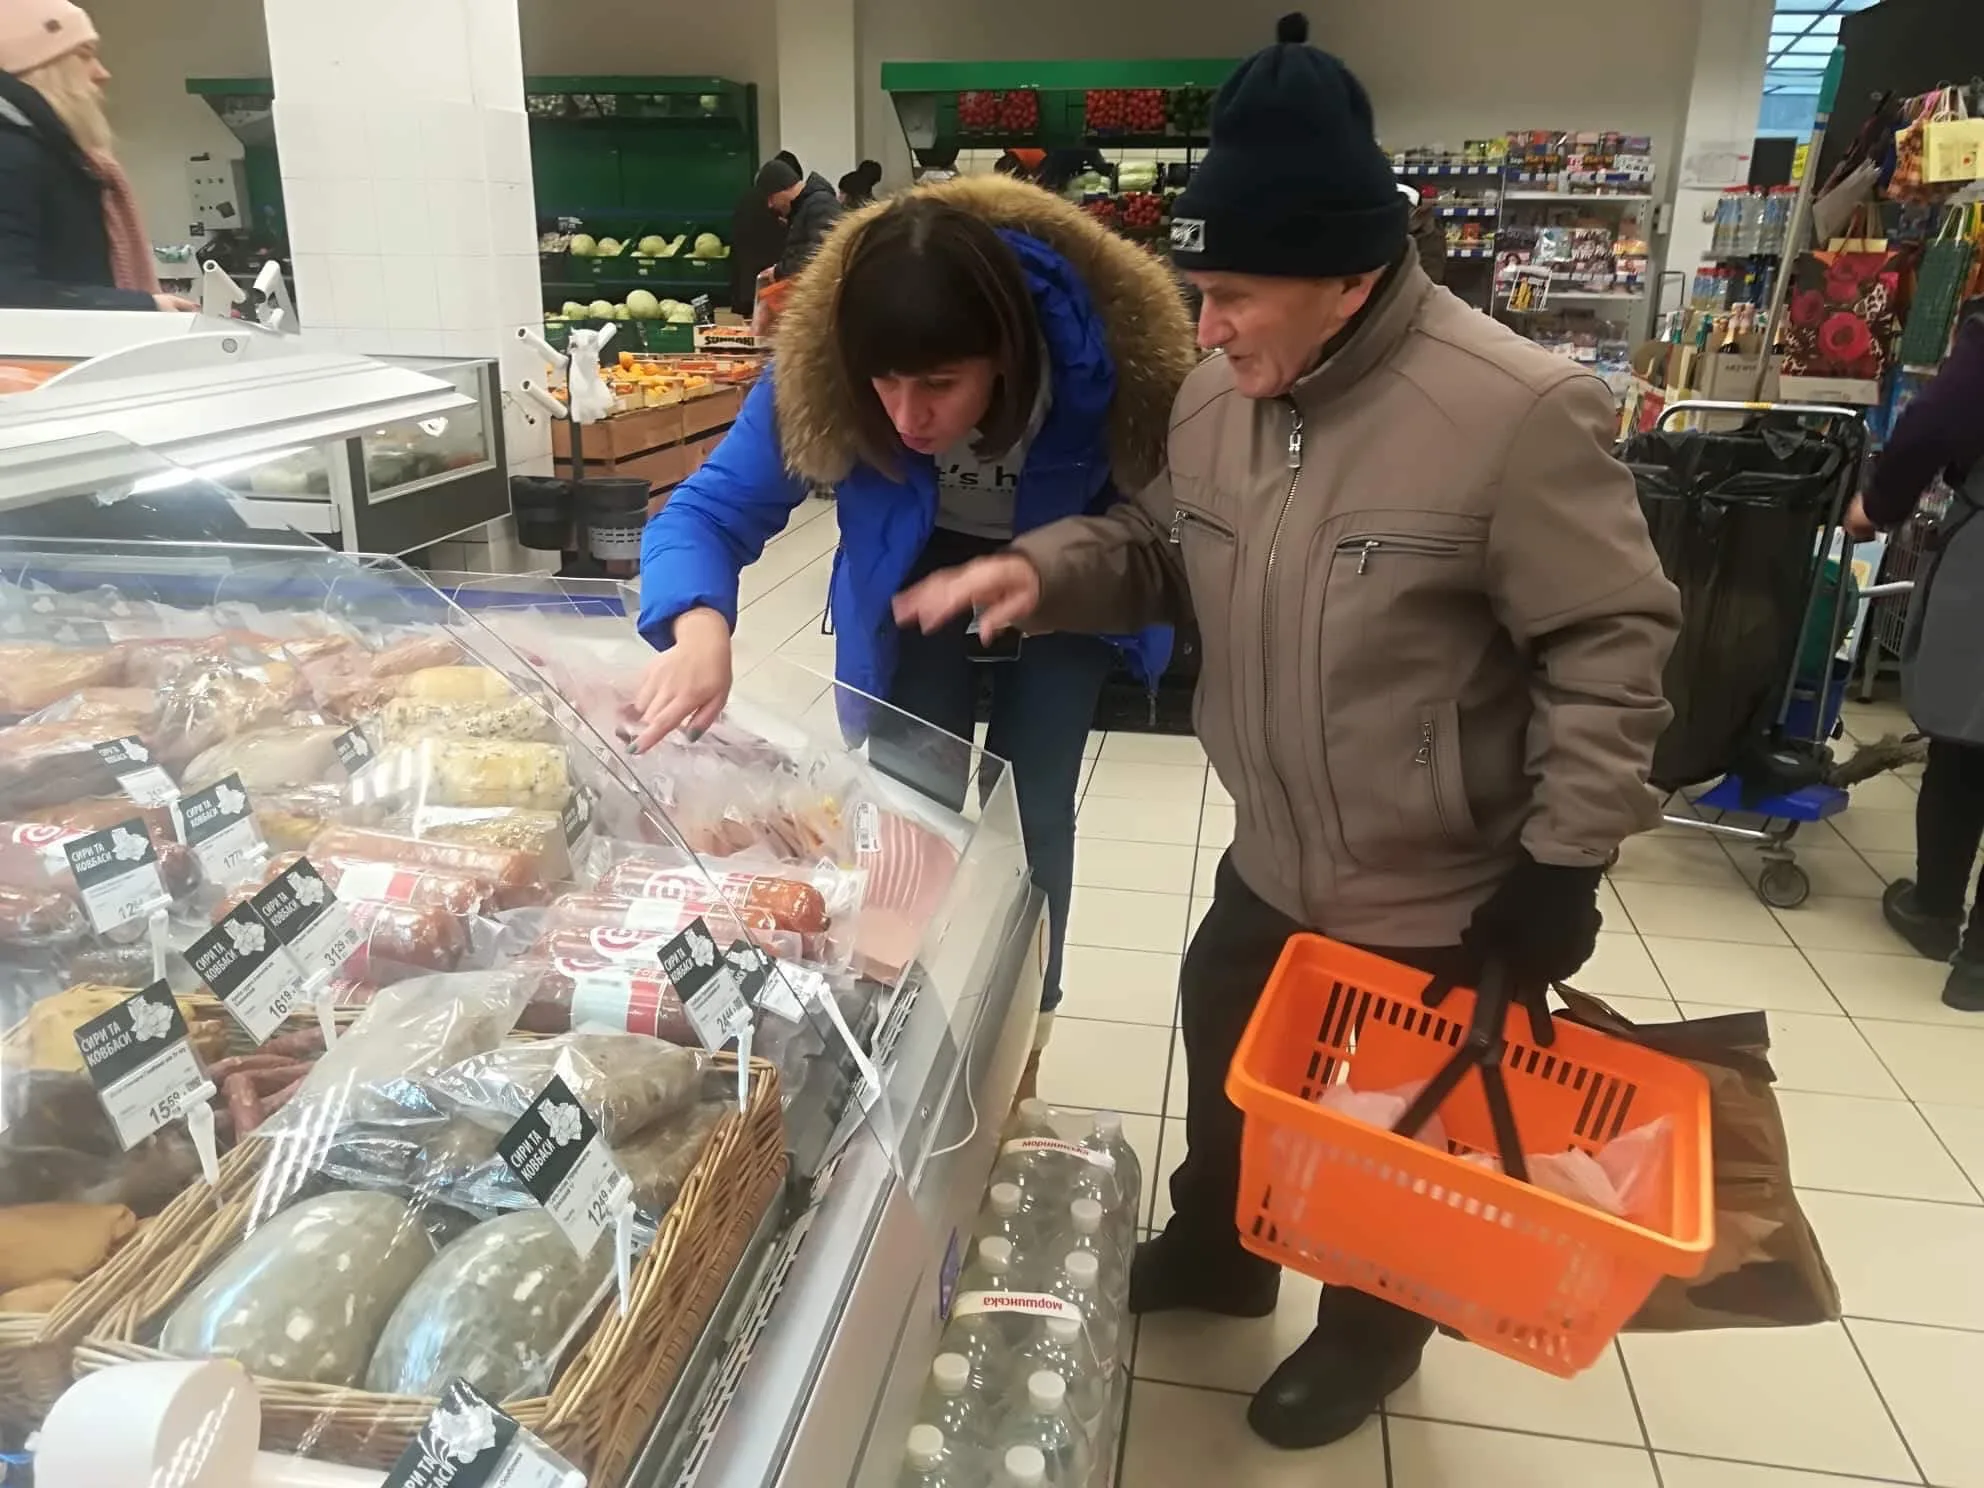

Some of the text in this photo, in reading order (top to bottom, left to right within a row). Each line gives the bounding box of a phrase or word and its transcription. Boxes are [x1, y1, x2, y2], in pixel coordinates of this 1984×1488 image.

[71, 843, 105, 863] СИРИ ТА
[75, 852, 113, 873] КОВБАСИ
[195, 942, 226, 972] СИРИ ТА
[204, 948, 238, 983] КОВБАСИ
[80, 1021, 122, 1053] СИРИ ТА
[86, 1031, 133, 1067] КОВБАСИ
[510, 1129, 544, 1169] СИРИ ТА
[520, 1137, 557, 1183] КОВБАСИ
[983, 1296, 1063, 1310] моршинська
[421, 1454, 439, 1476] ТА
